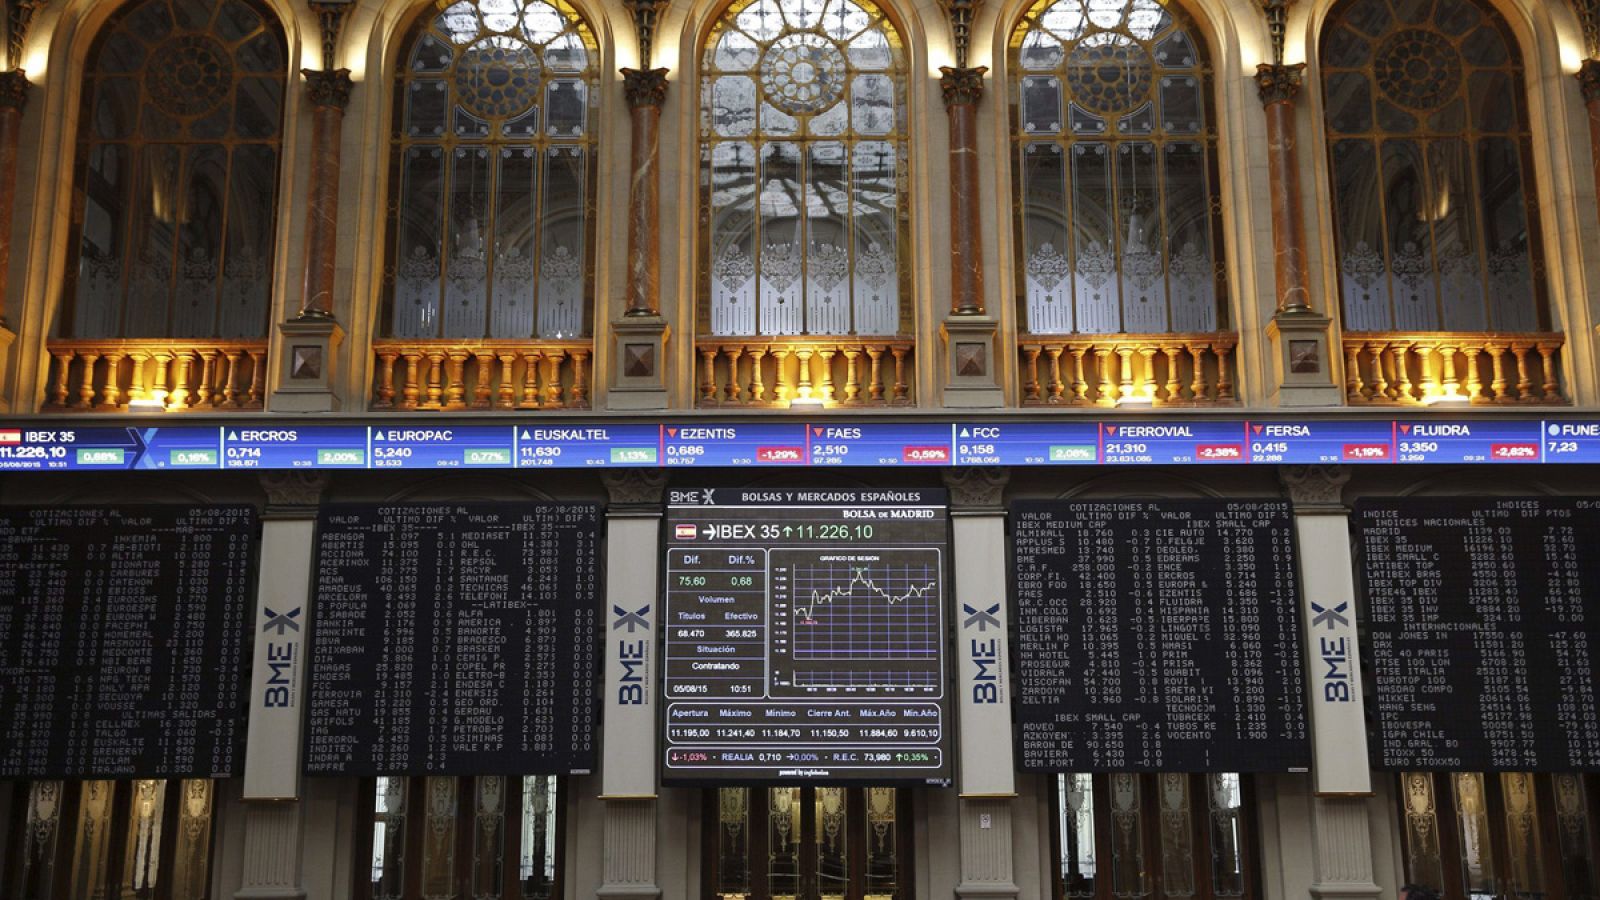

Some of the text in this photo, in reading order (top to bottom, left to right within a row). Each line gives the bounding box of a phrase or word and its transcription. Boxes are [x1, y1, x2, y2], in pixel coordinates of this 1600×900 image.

[535, 430, 610, 440] EUSKALTEL
[680, 428, 736, 440] EZENTIS
[826, 428, 861, 438] FAES
[972, 428, 1000, 438] FCC
[1119, 426, 1193, 437] FERROVIAL
[1266, 426, 1310, 436] FERSA
[1413, 425, 1470, 436] FLUIDRA
[1562, 425, 1600, 435] FUNE
[25, 432, 76, 442] IBEX 35
[242, 431, 297, 442] ERCROS
[388, 430, 453, 441] EUROPAC
[521, 446, 561, 457] 11,630
[667, 446, 705, 456] 0,686
[814, 445, 848, 455] 2,510
[960, 445, 994, 455] 9,158
[1106, 444, 1147, 454] 21,310
[1252, 443, 1288, 454] 0,415
[1400, 442, 1438, 452] 3,350
[1548, 442, 1578, 452] 7,23
[228, 448, 261, 458] 0,714
[374, 448, 412, 458] 5,240
[670, 492, 699, 503] BME
[742, 490, 920, 502] BOLSAS Y MERCADOS ESPAÑOLES
[842, 510, 876, 518] BOLSA
[890, 510, 934, 518] MADRID
[716, 526, 873, 540] IBEX 35 11.226,10
[684, 556, 701, 564] Dif.
[698, 596, 736, 604] Volumen
[724, 612, 758, 620] Efectivo
[696, 645, 736, 653] Situación
[692, 662, 740, 670] Contratando
[972, 639, 997, 703] BME
[1320, 637, 1348, 702] BME
[264, 642, 292, 707] BME
[618, 640, 644, 704] BME
[730, 684, 752, 692] 10:51
[672, 710, 709, 718] Apertura
[720, 708, 752, 718] Máximo
[807, 709, 833, 718] Cierre
[834, 709, 851, 718] Ant.
[722, 752, 754, 762] REALIA
[759, 752, 782, 762] 0,710
[832, 752, 859, 762] R.E.C.
